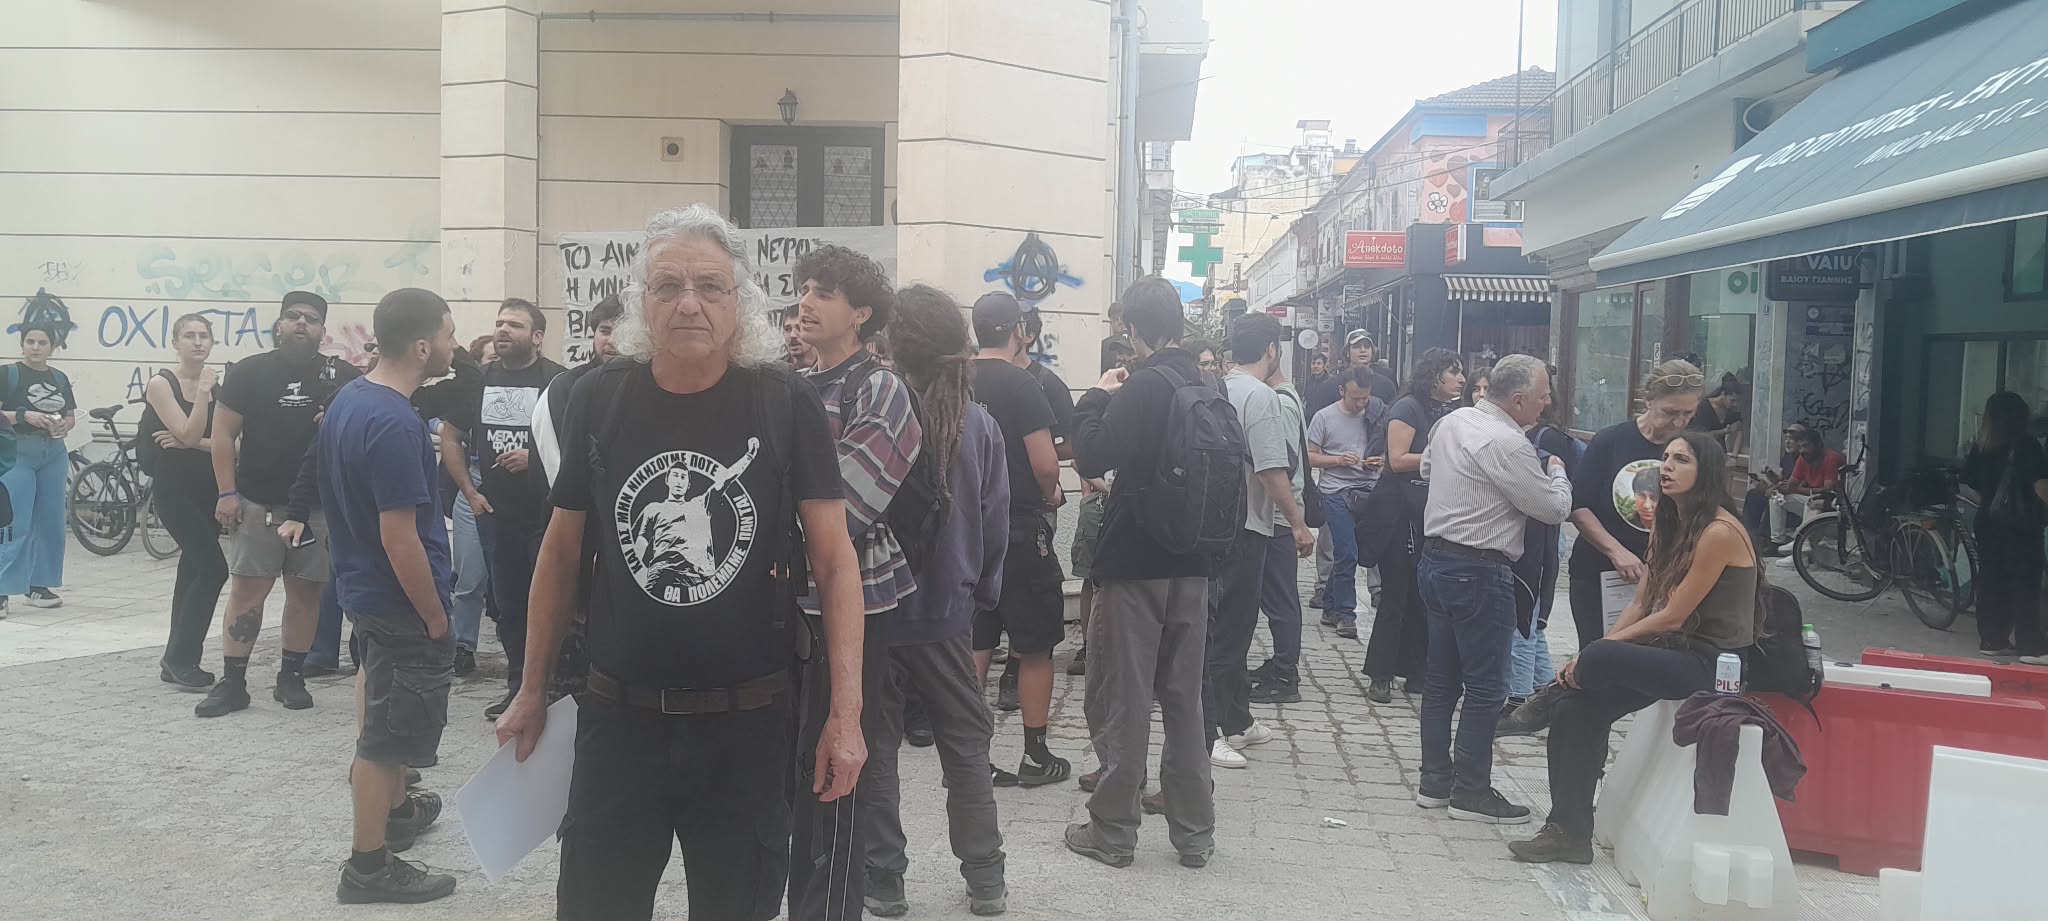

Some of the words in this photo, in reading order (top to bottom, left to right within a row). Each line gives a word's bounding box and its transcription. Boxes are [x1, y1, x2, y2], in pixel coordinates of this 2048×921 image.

[1754, 91, 1954, 173] ΦΩΤΟΤΥΠΙΕΣ
[1854, 108, 2003, 168] ΝΙΚΟΛΑΟΣ
[559, 242, 591, 273] ΤΟ
[1347, 240, 1404, 254] Anekdoto
[1807, 255, 1853, 271] VAIU
[566, 276, 580, 302] Η
[98, 305, 169, 349] ΟΧΙ
[627, 452, 687, 493] ΝΙΚΗΣΟΥΜΕ
[690, 453, 720, 477] ΠΟΤΕ
[617, 492, 632, 524] ΜΗΝ
[624, 548, 644, 575] ΚΑΙ
[663, 585, 681, 603] ΘΑ
[687, 545, 747, 602] ΠΟΛΕΜΑΜΕ
[1716, 679, 1740, 691] PILS
